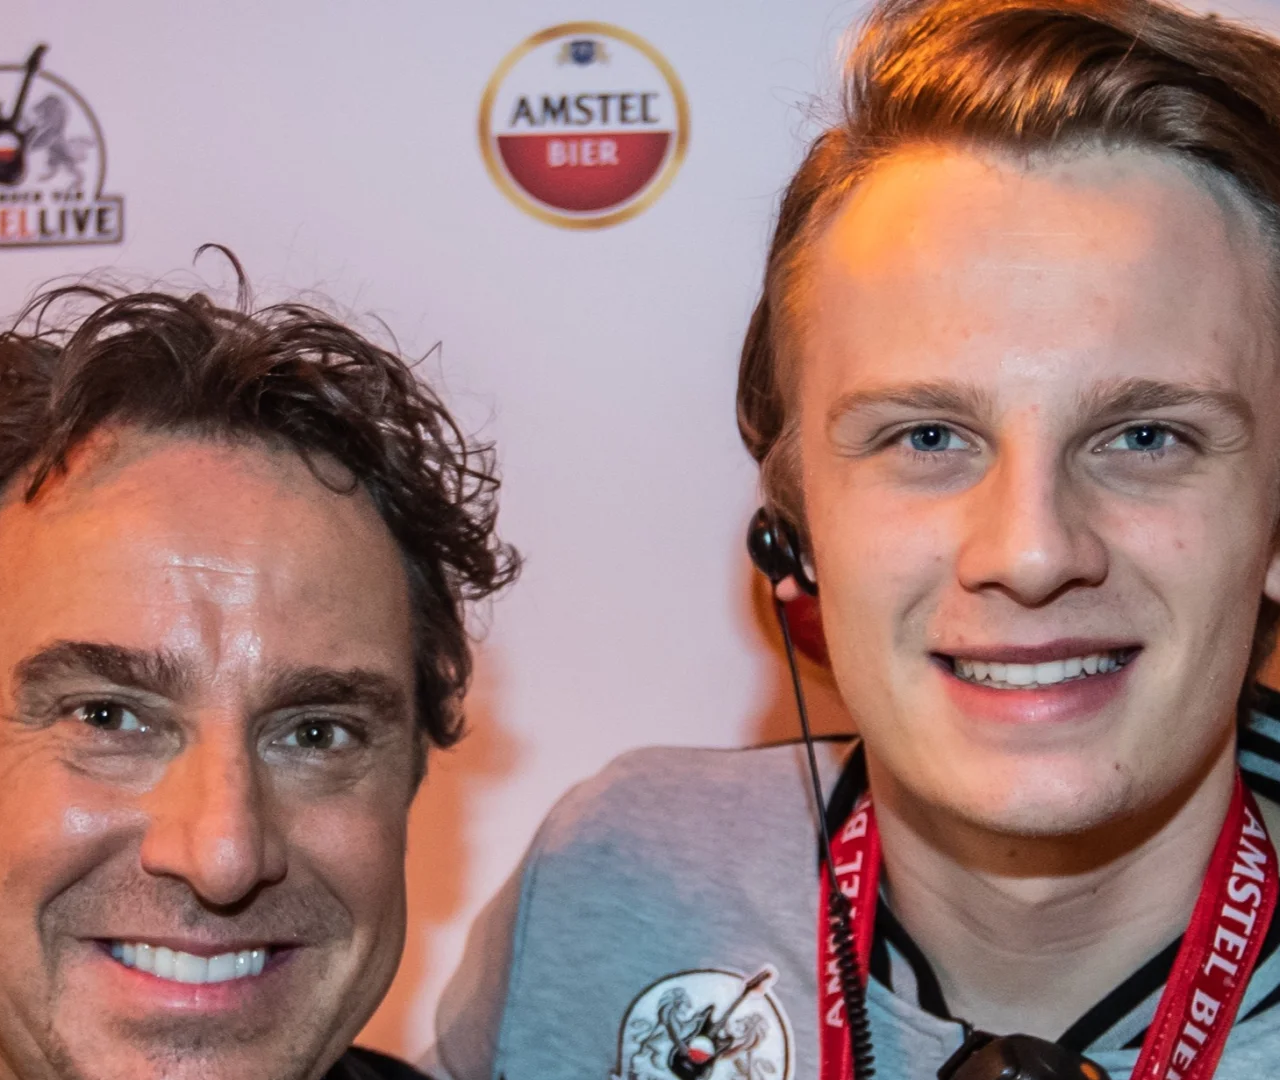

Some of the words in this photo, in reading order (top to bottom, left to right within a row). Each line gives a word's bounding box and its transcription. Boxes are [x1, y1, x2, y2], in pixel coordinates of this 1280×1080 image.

[510, 93, 660, 126] AMSTEL
[546, 140, 619, 167] BIER
[1203, 806, 1266, 977] AMSTEL
